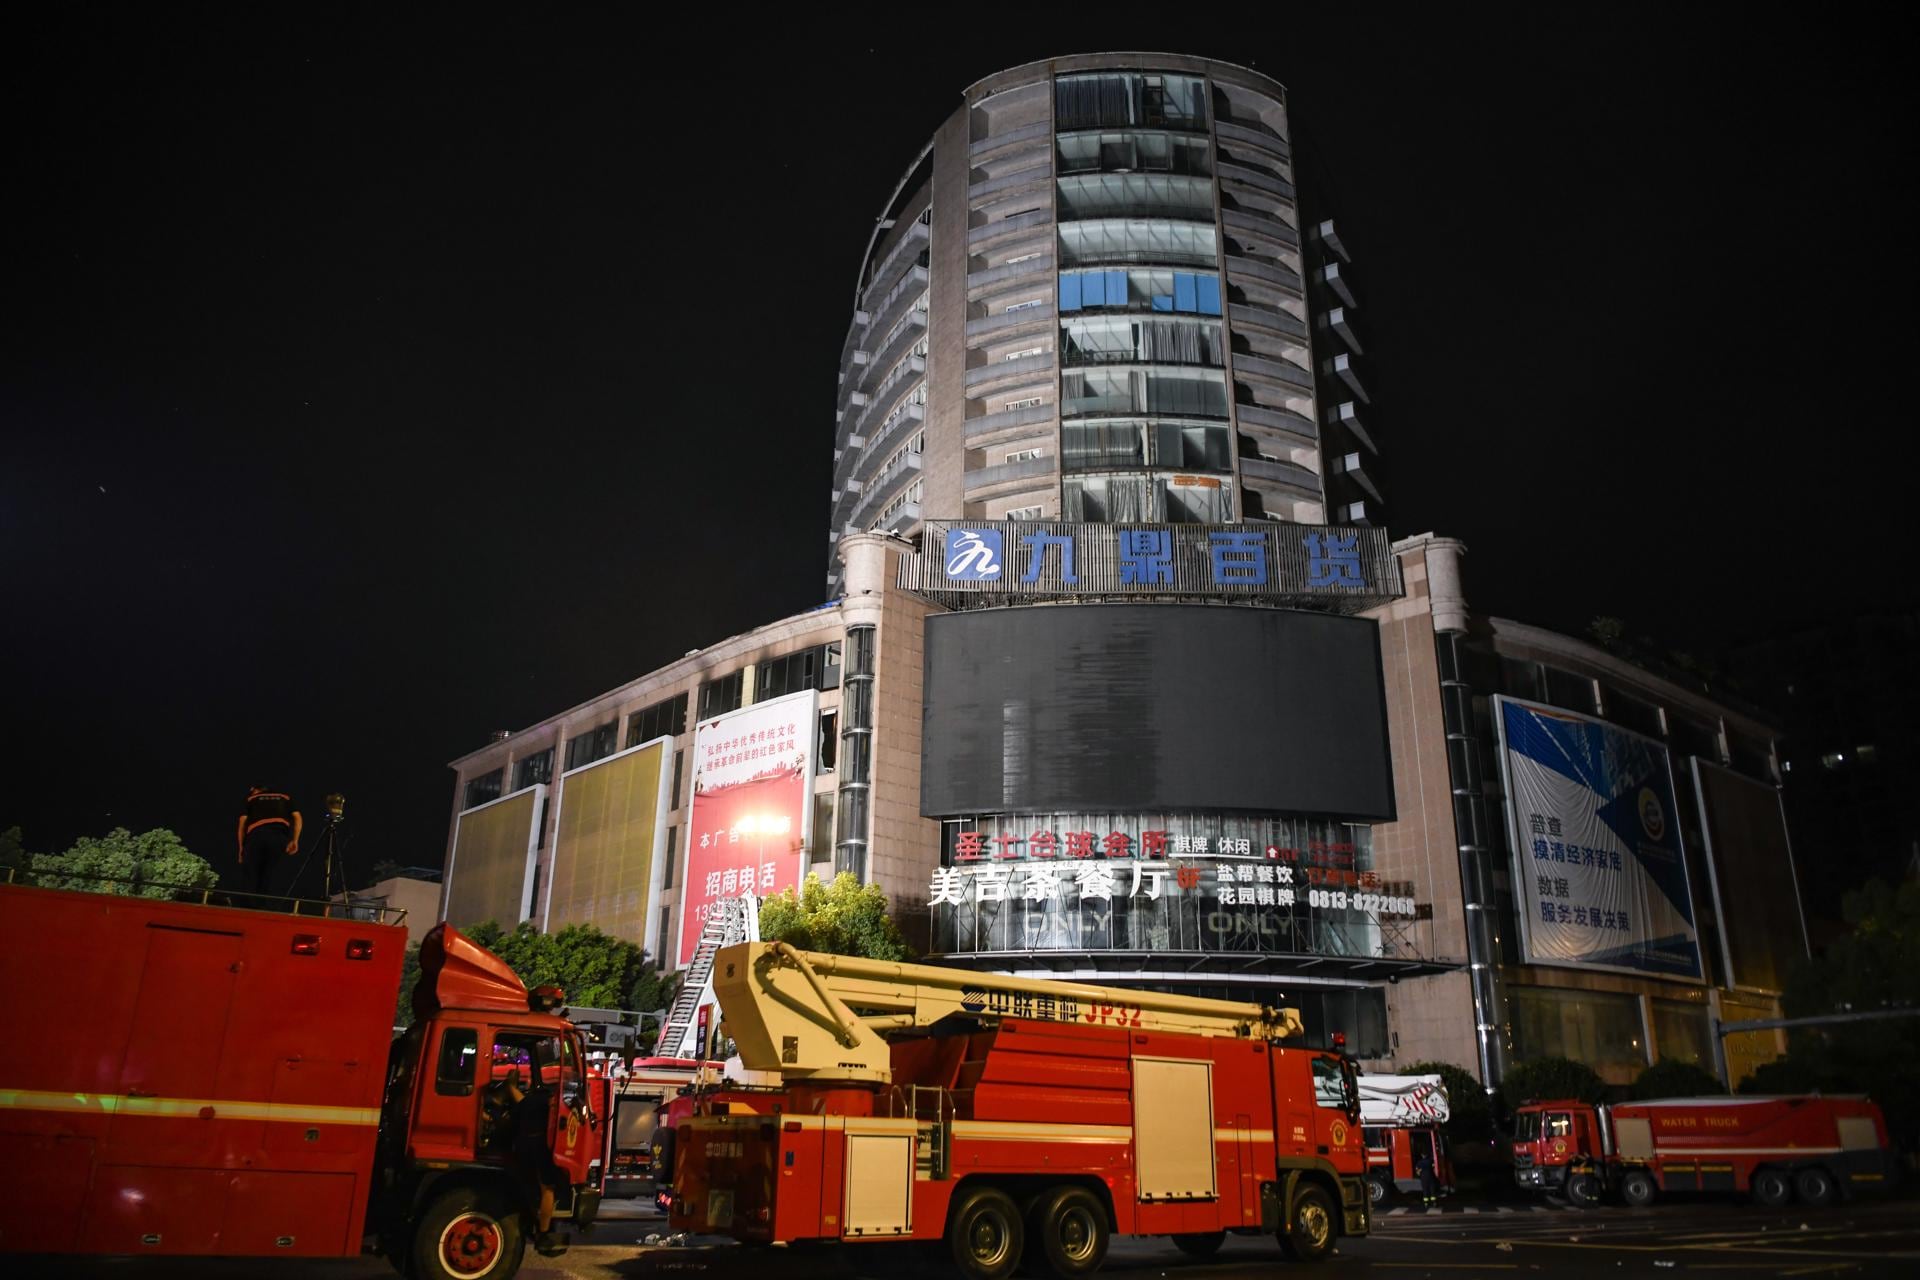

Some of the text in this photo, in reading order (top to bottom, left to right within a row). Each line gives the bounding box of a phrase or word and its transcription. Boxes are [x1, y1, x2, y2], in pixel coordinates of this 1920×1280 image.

[1021, 529, 1366, 587] 九鼎百货
[707, 722, 797, 757] 弘扬中华优秀传统文化
[1174, 835, 1208, 853] 棋牌
[1217, 836, 1250, 855] 休闲
[1533, 838, 1622, 872] 摸清经济家底
[704, 861, 777, 897] 招商电话
[927, 860, 1171, 906] 美吉茶餐厅
[1216, 863, 1294, 884] 盐帮餐饮
[1216, 887, 1295, 906] 花园棋牌
[1536, 876, 1570, 898] 数据
[1308, 889, 1416, 915] 0813-8222868
[1024, 910, 1111, 934] ONLY
[1207, 911, 1293, 935] ONLY
[1540, 901, 1631, 932] 服务发展决策
[989, 988, 1142, 1028] 中联重科 JP32
[1660, 1116, 1740, 1128] WATER TRUCK
